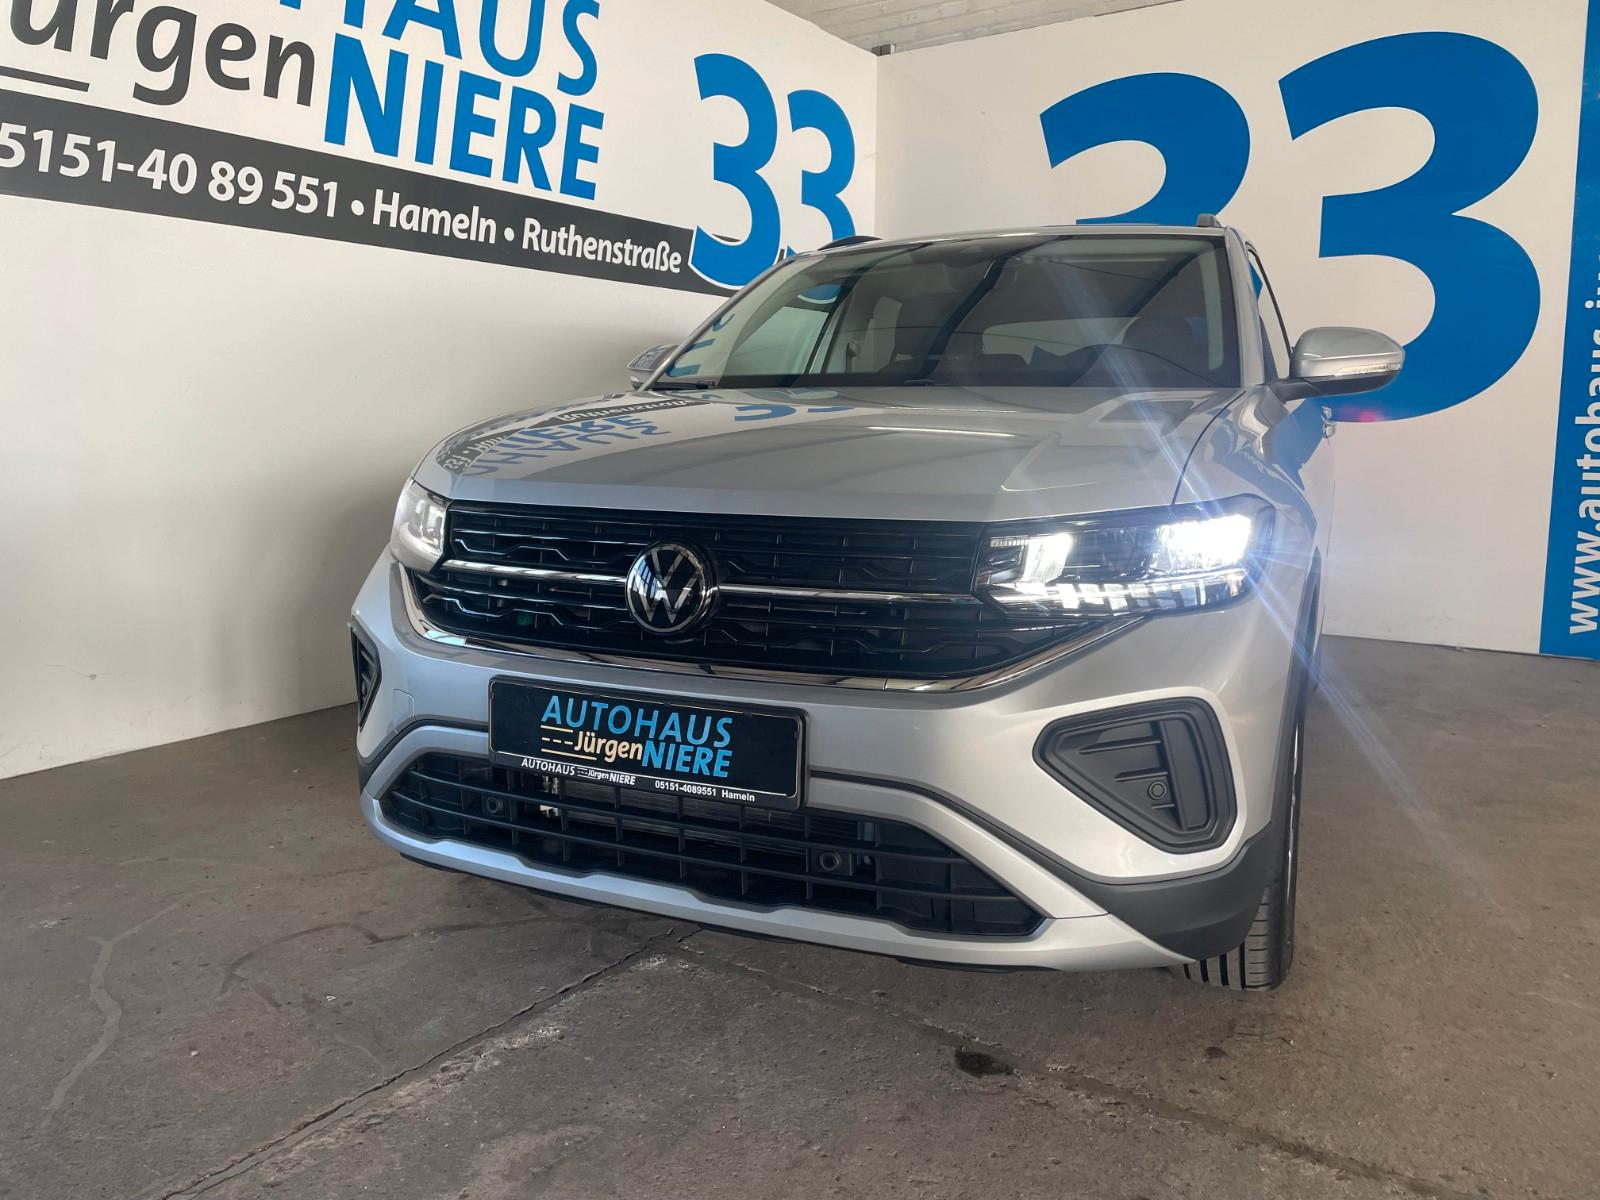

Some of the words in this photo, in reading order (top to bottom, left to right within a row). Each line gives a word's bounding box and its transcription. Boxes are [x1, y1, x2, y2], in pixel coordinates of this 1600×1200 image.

[280, 0, 601, 97] AUS
[324, 32, 605, 201] NIERE
[0, 122, 198, 195] 5151-40
[207, 160, 264, 205] 89
[271, 170, 338, 218] 551
[372, 188, 497, 244] Hameln
[521, 217, 683, 273] Ruthenstraße
[690, 53, 857, 287] 33
[540, 695, 733, 748] AUTOHAUS
[574, 730, 643, 763] Jürgen
[641, 739, 733, 778] NIERE
[521, 758, 575, 776] AUTOHAUS
[609, 772, 637, 786] NIERE
[655, 780, 717, 796] 05151-4089551
[721, 789, 755, 802] Hameln
